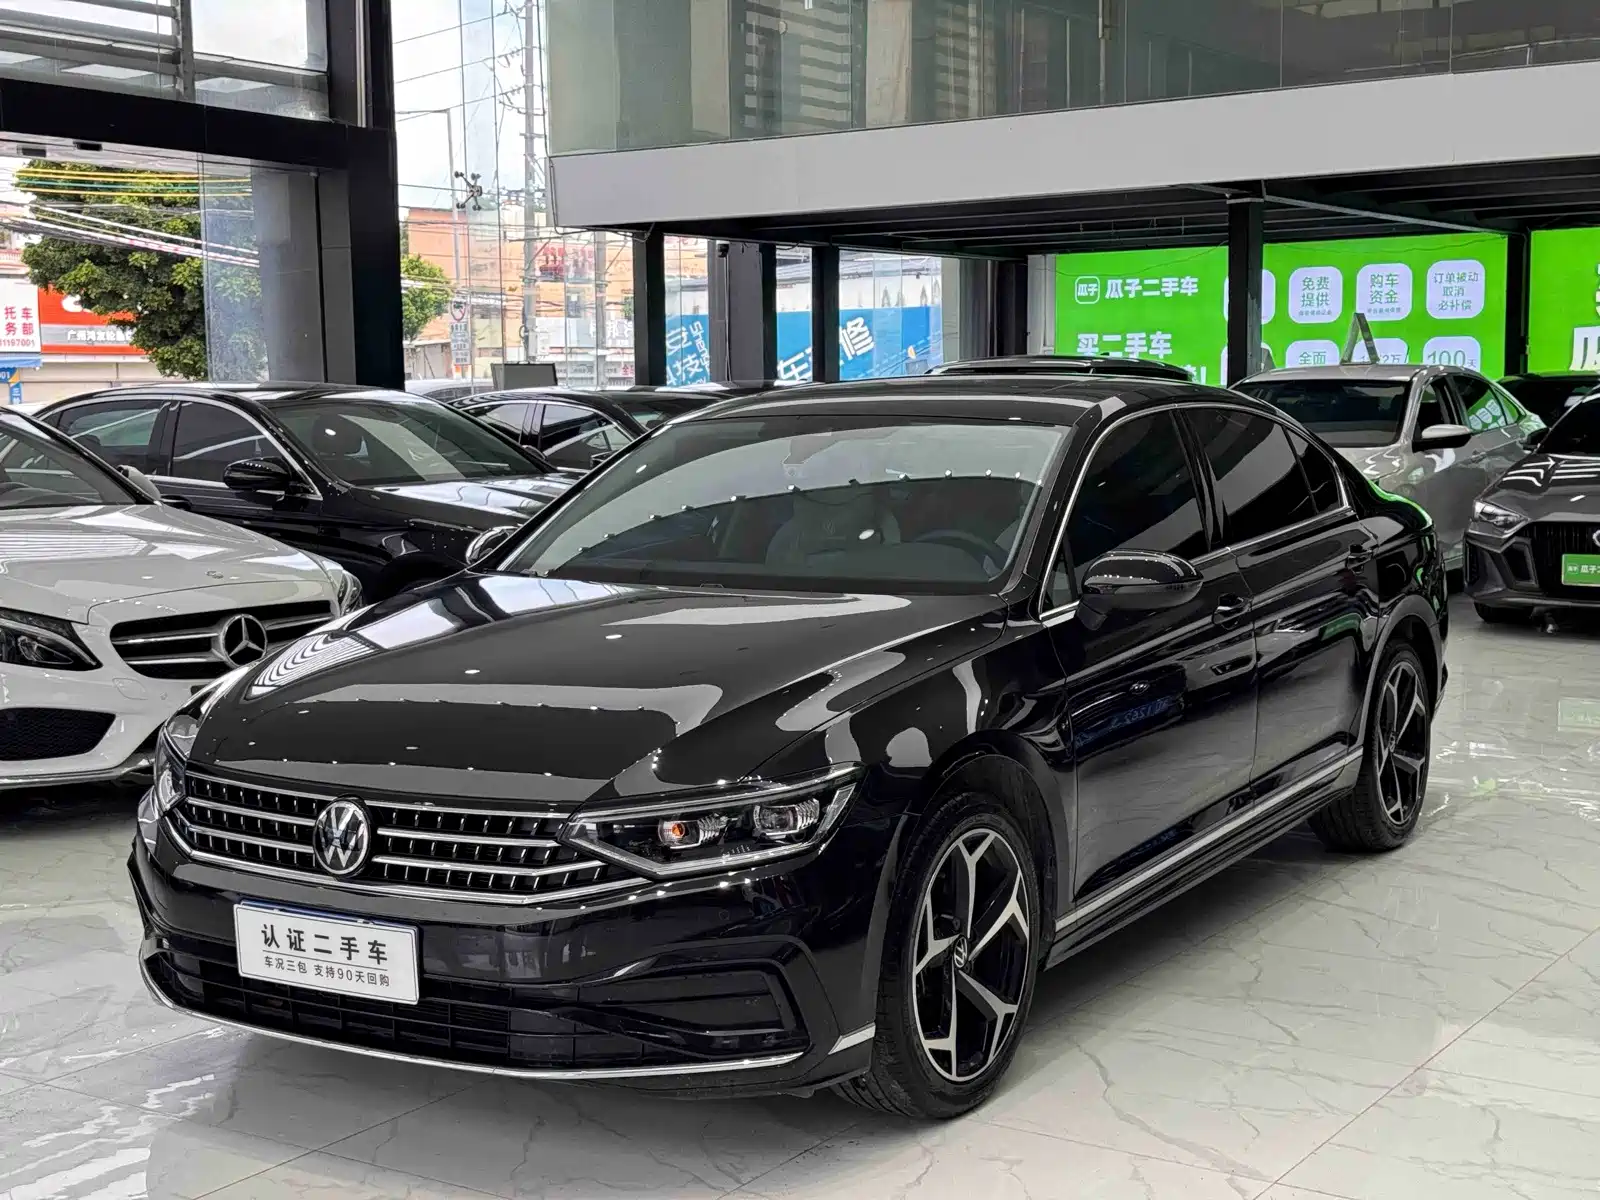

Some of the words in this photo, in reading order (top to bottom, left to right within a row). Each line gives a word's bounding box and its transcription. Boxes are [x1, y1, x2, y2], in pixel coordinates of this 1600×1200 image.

[1302, 276, 1329, 291] 免费
[1370, 273, 1399, 288] 购车
[1434, 272, 1479, 284] 订单被动
[1077, 283, 1098, 297] 瓜子
[1105, 276, 1198, 298] 瓜子二手车
[1442, 286, 1465, 298] 取消
[1301, 292, 1330, 307] 提供
[1369, 289, 1399, 304] 资金
[4, 306, 33, 320] 托车
[1438, 300, 1472, 311] 必补偿
[4, 322, 34, 336] 务部
[1077, 331, 1172, 359] 买二手车
[1299, 351, 1327, 364] 全面
[261, 923, 388, 966] 认证二手车
[264, 955, 308, 975] 车况三包
[314, 964, 390, 988] 支持90天回购
